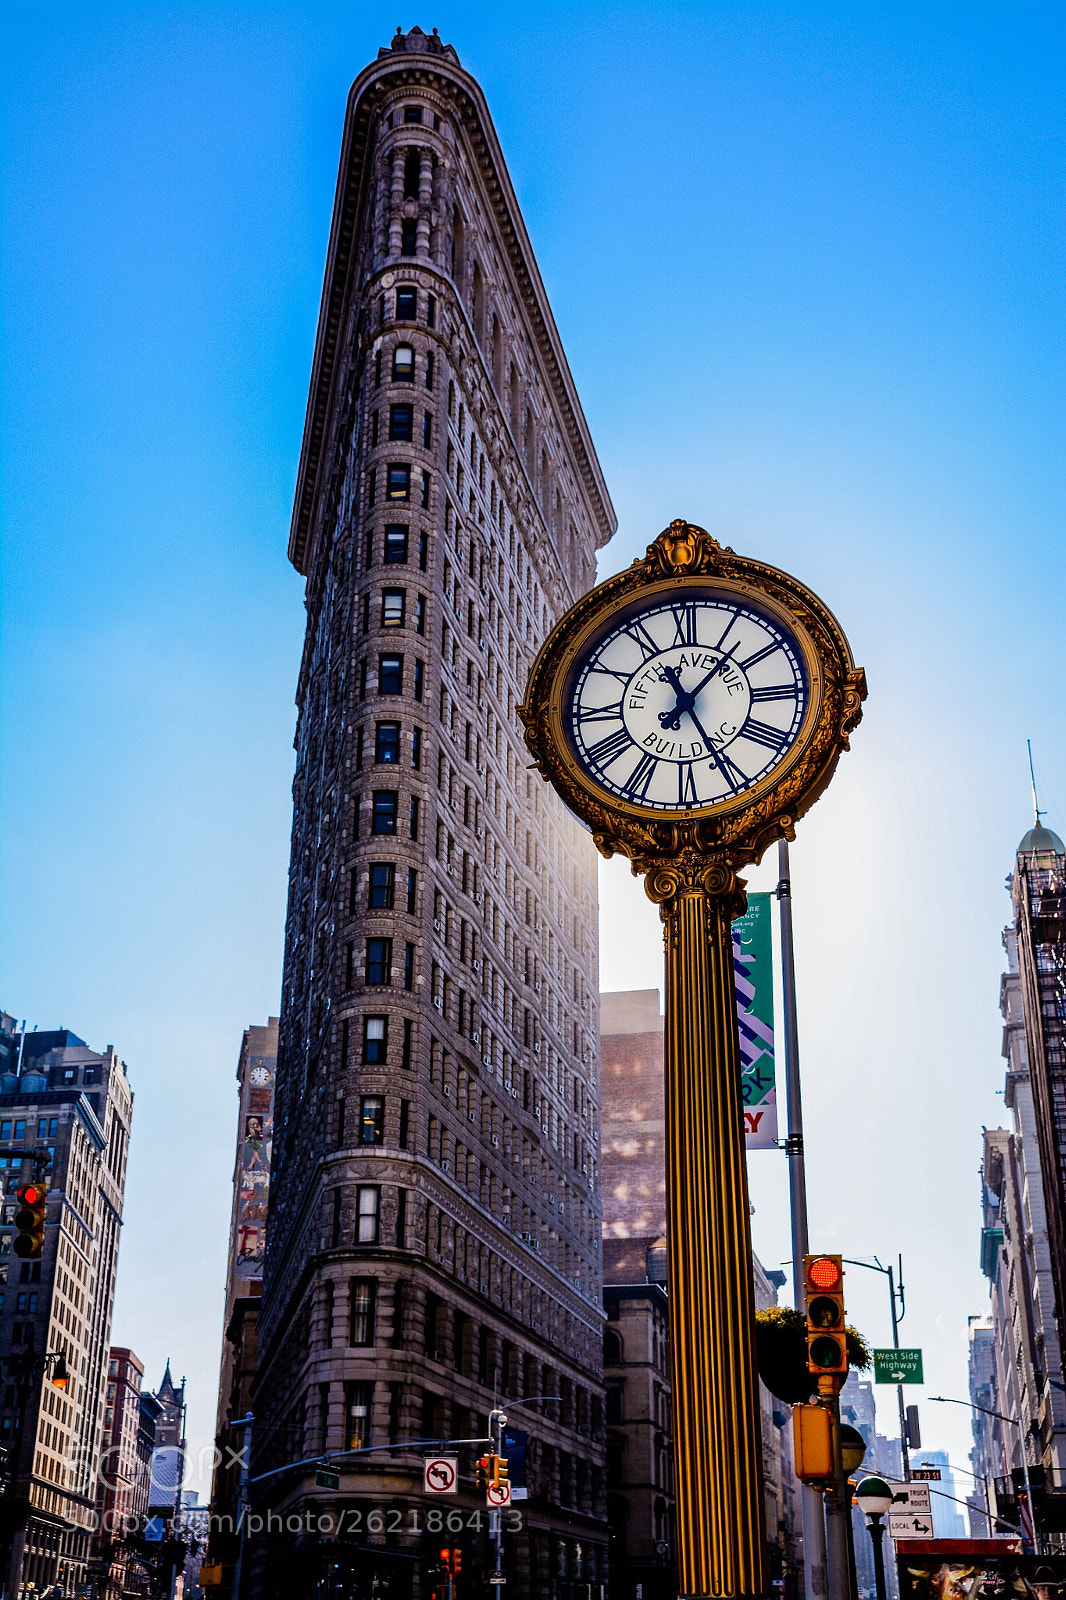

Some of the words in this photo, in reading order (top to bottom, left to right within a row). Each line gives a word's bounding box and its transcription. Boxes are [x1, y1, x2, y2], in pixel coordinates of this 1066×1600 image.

[642, 721, 737, 759] BUILDNG
[876, 1352, 898, 1360] West
[900, 1351, 919, 1360] Side
[880, 1360, 917, 1371] Highway
[923, 1472, 931, 1480] 23
[910, 1499, 929, 1507] ROUTE
[891, 1522, 910, 1530] LOCAL
